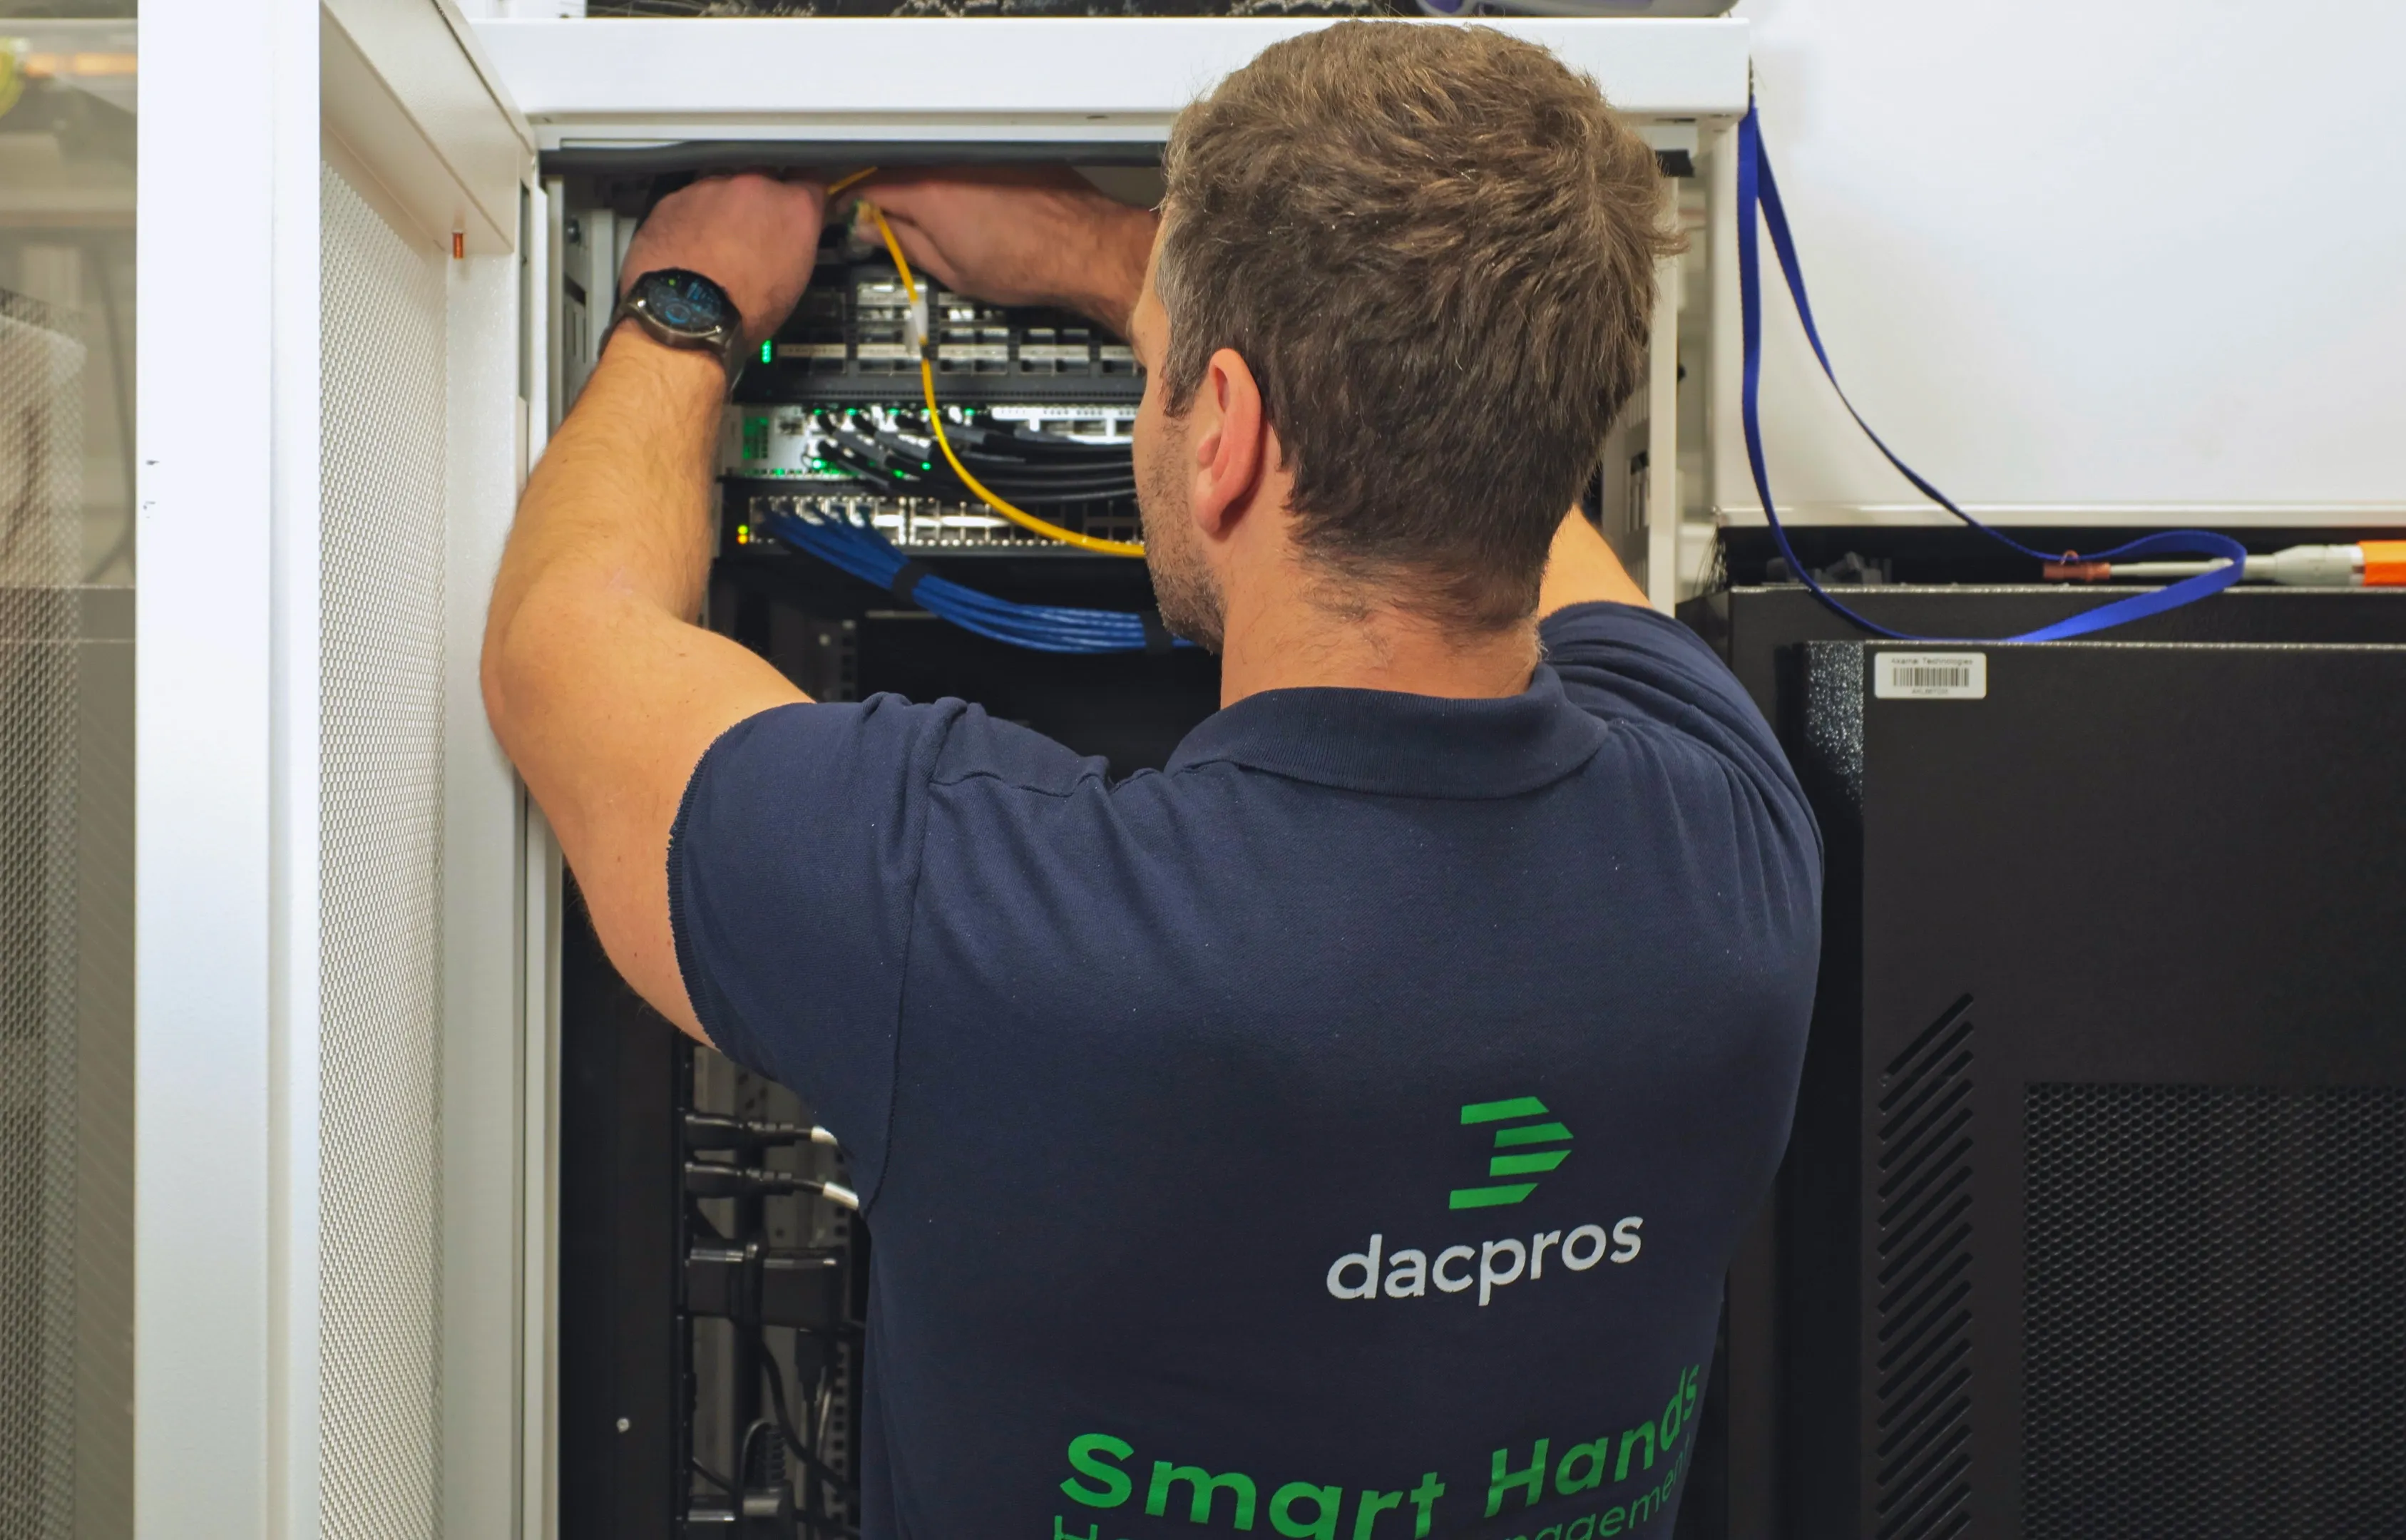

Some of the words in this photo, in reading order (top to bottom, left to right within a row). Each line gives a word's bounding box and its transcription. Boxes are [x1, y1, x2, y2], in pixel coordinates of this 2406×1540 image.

[1326, 1216, 1644, 1307] dacpros
[1060, 1432, 1445, 1540] Smart
[1485, 1365, 1700, 1519] Hands
